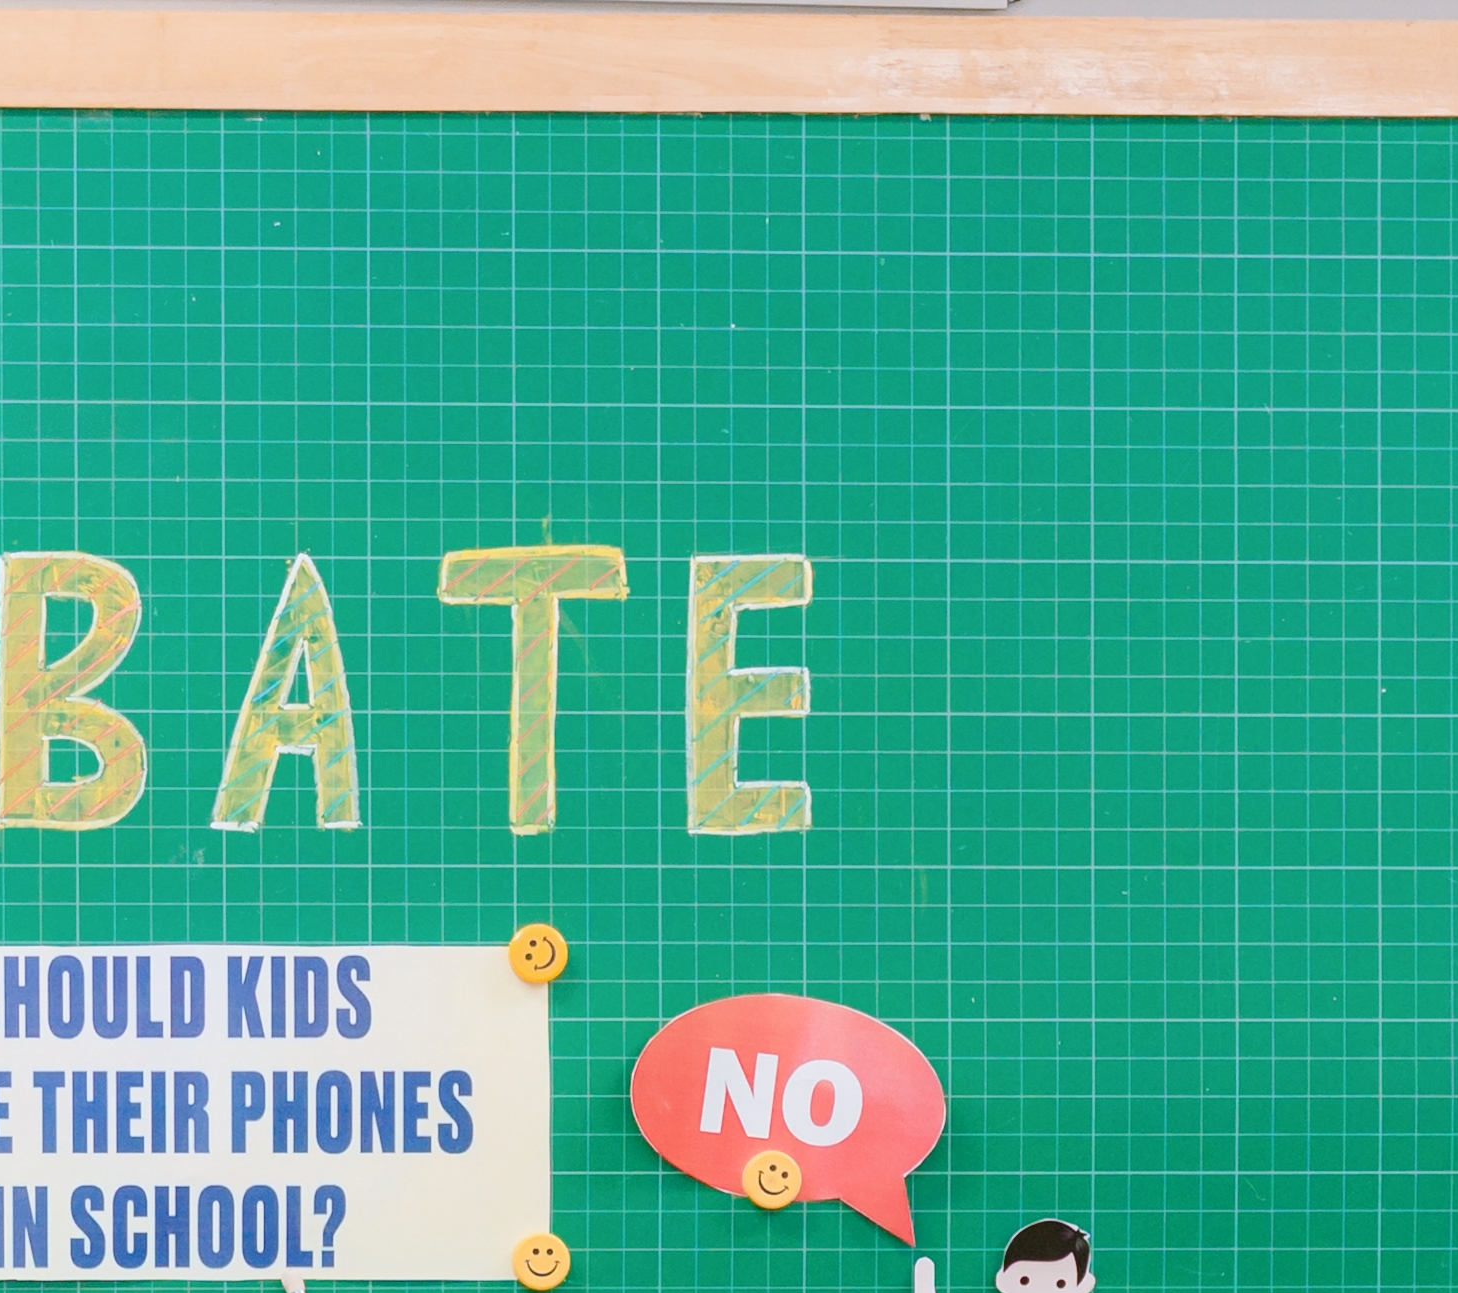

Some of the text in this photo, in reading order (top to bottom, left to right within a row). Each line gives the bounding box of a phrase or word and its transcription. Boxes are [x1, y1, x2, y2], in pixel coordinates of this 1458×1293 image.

[227, 954, 373, 1040] KIDS
[33, 1069, 210, 1155] THEIR
[230, 1069, 475, 1155] PHONES
[699, 1046, 864, 1147] NO
[69, 1184, 347, 1270] SCHOOL?
